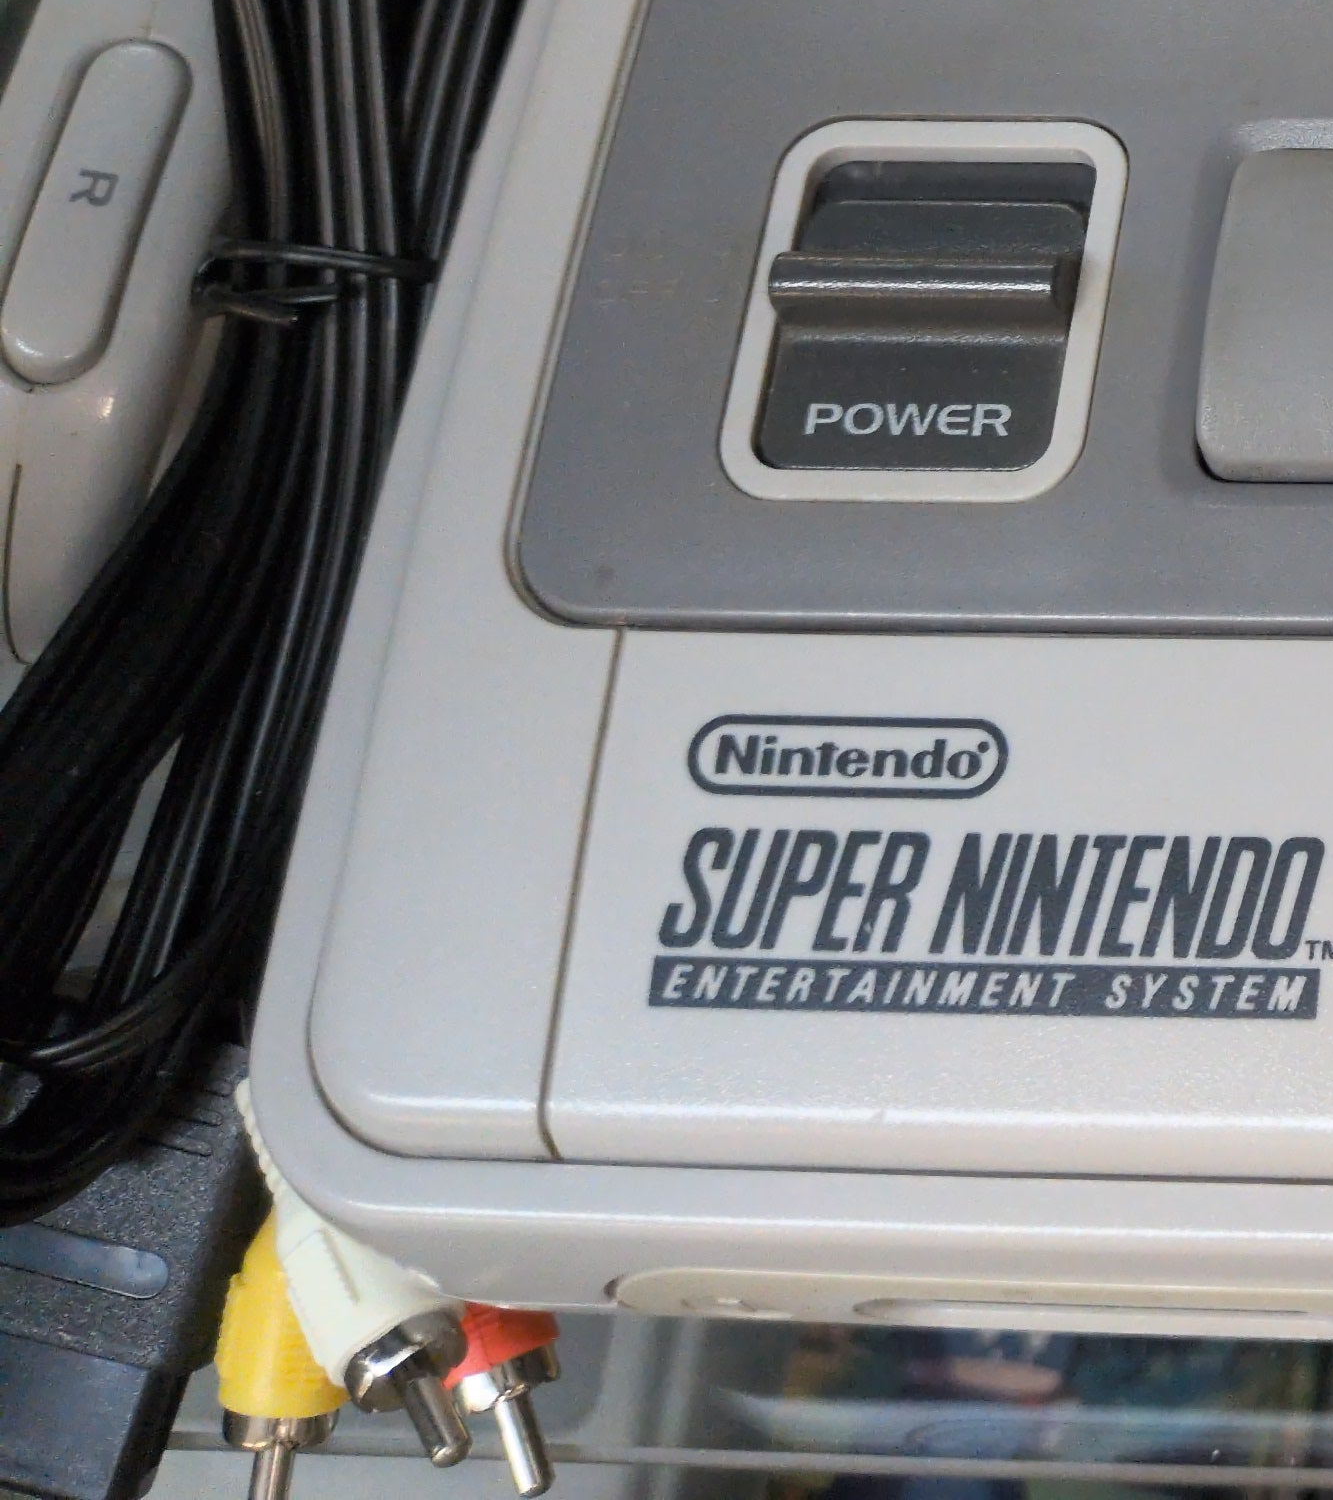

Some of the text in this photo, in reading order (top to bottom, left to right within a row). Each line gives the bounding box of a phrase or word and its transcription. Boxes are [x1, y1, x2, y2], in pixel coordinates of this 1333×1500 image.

[68, 167, 120, 208] R
[801, 402, 1013, 437] POWER
[713, 734, 985, 781] Nintendo
[657, 826, 930, 956] SUPER
[929, 831, 1326, 960] NINTENDO
[661, 962, 1308, 1013] ENTERTAINMENT SYSTEM
